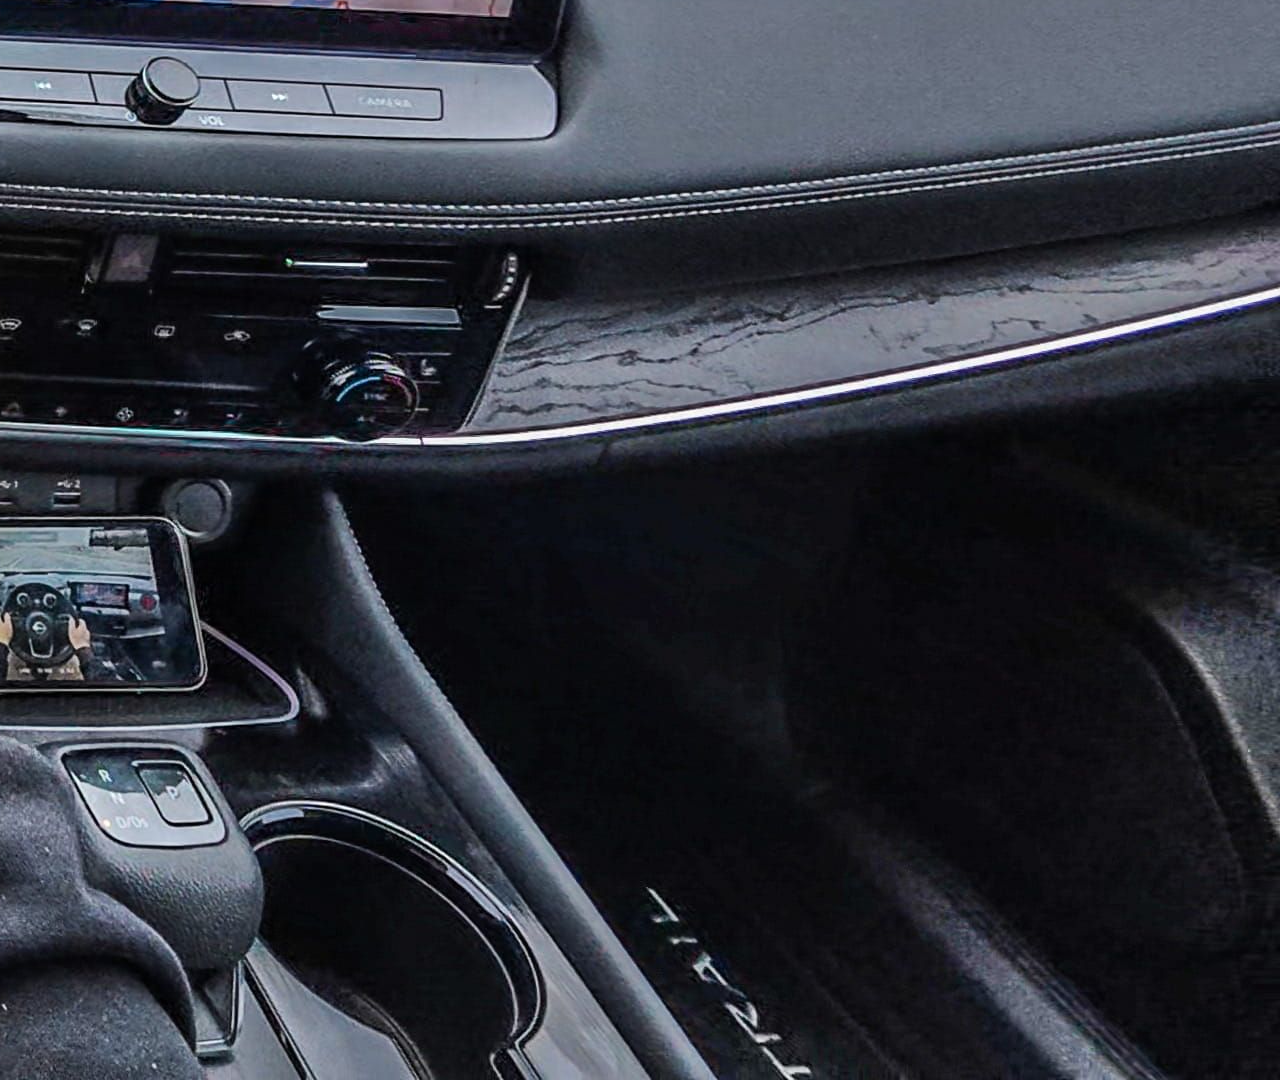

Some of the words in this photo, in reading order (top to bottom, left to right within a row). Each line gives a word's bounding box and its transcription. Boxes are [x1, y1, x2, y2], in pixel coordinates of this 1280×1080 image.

[199, 115, 225, 126] VOL
[98, 769, 112, 783] R
[166, 785, 180, 800] P
